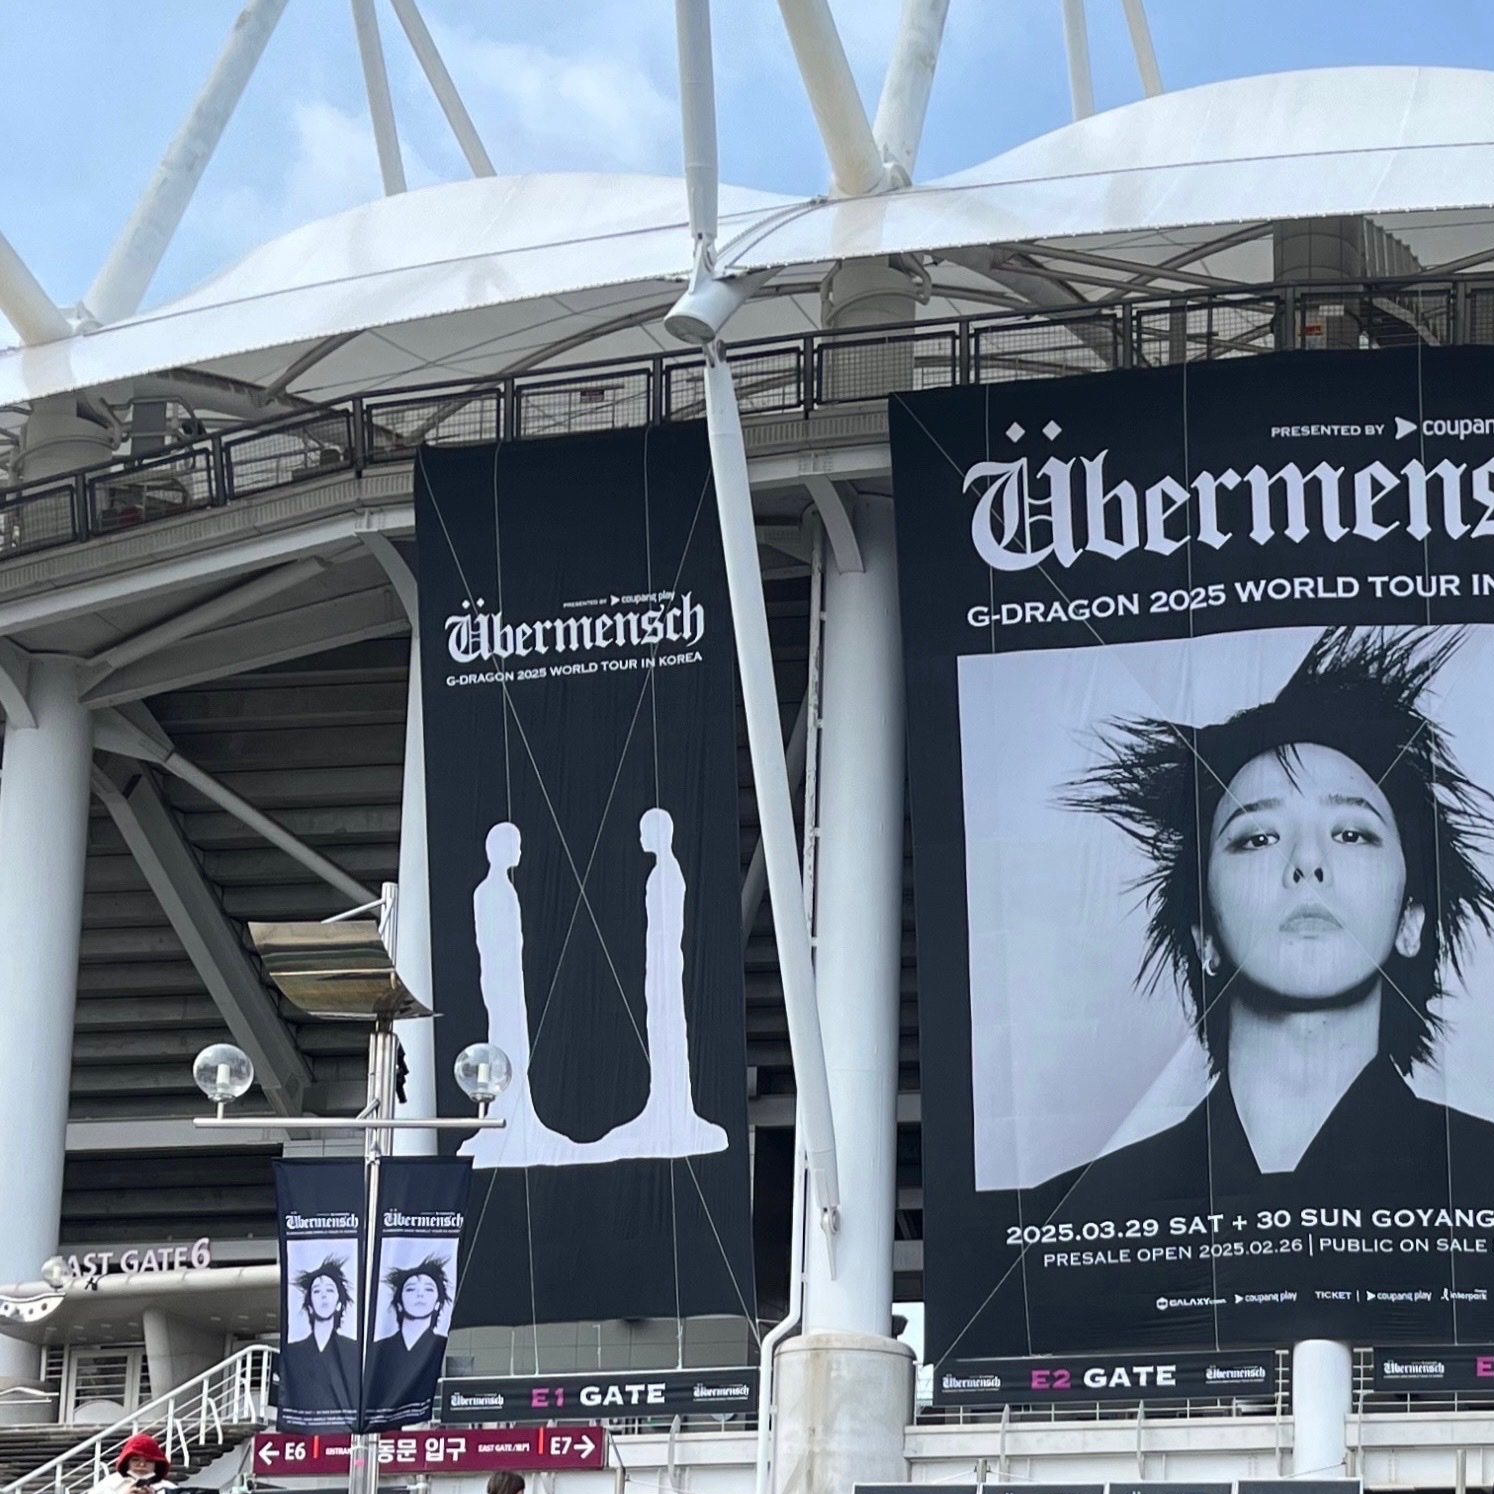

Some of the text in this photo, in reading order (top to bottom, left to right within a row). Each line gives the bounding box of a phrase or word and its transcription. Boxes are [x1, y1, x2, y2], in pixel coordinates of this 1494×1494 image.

[1271, 424, 1361, 439] PRESENTED
[1365, 423, 1385, 436] BY
[621, 592, 657, 604] coupang
[658, 590, 675, 603] play
[967, 594, 1140, 628] G-DRAGON
[1150, 584, 1227, 613] 2025
[1237, 576, 1356, 603] WORLD
[1367, 573, 1459, 598] TOUR
[444, 591, 705, 663] Übermensch
[446, 651, 703, 686] G-DRAGON 2025 WORLD TOUR IN KOREA
[285, 1211, 359, 1230] Übermensch
[383, 1208, 464, 1228] Übermensch
[1006, 1218, 1159, 1245] 2025.03.29
[1169, 1213, 1224, 1235] SAT
[1232, 1214, 1249, 1232] +
[1256, 1210, 1292, 1230] 30
[1300, 1207, 1363, 1228] SUN
[66, 1252, 113, 1278] AST
[120, 1247, 188, 1275] GATE
[1043, 1250, 1132, 1268] PRESALE
[1137, 1245, 1193, 1263] OPEN
[1199, 1238, 1303, 1259] 2025.02.26
[1319, 1237, 1393, 1254] PUBLIC
[1400, 1237, 1431, 1253] ON
[1436, 1237, 1487, 1253] SALE
[1315, 1291, 1352, 1300] TICKET
[1030, 1364, 1176, 1389] E2 GATE
[531, 1383, 666, 1408] E1 GATE
[285, 1441, 306, 1460] E6
[377, 1437, 467, 1463] 동문 입구
[550, 1437, 572, 1454] E7
